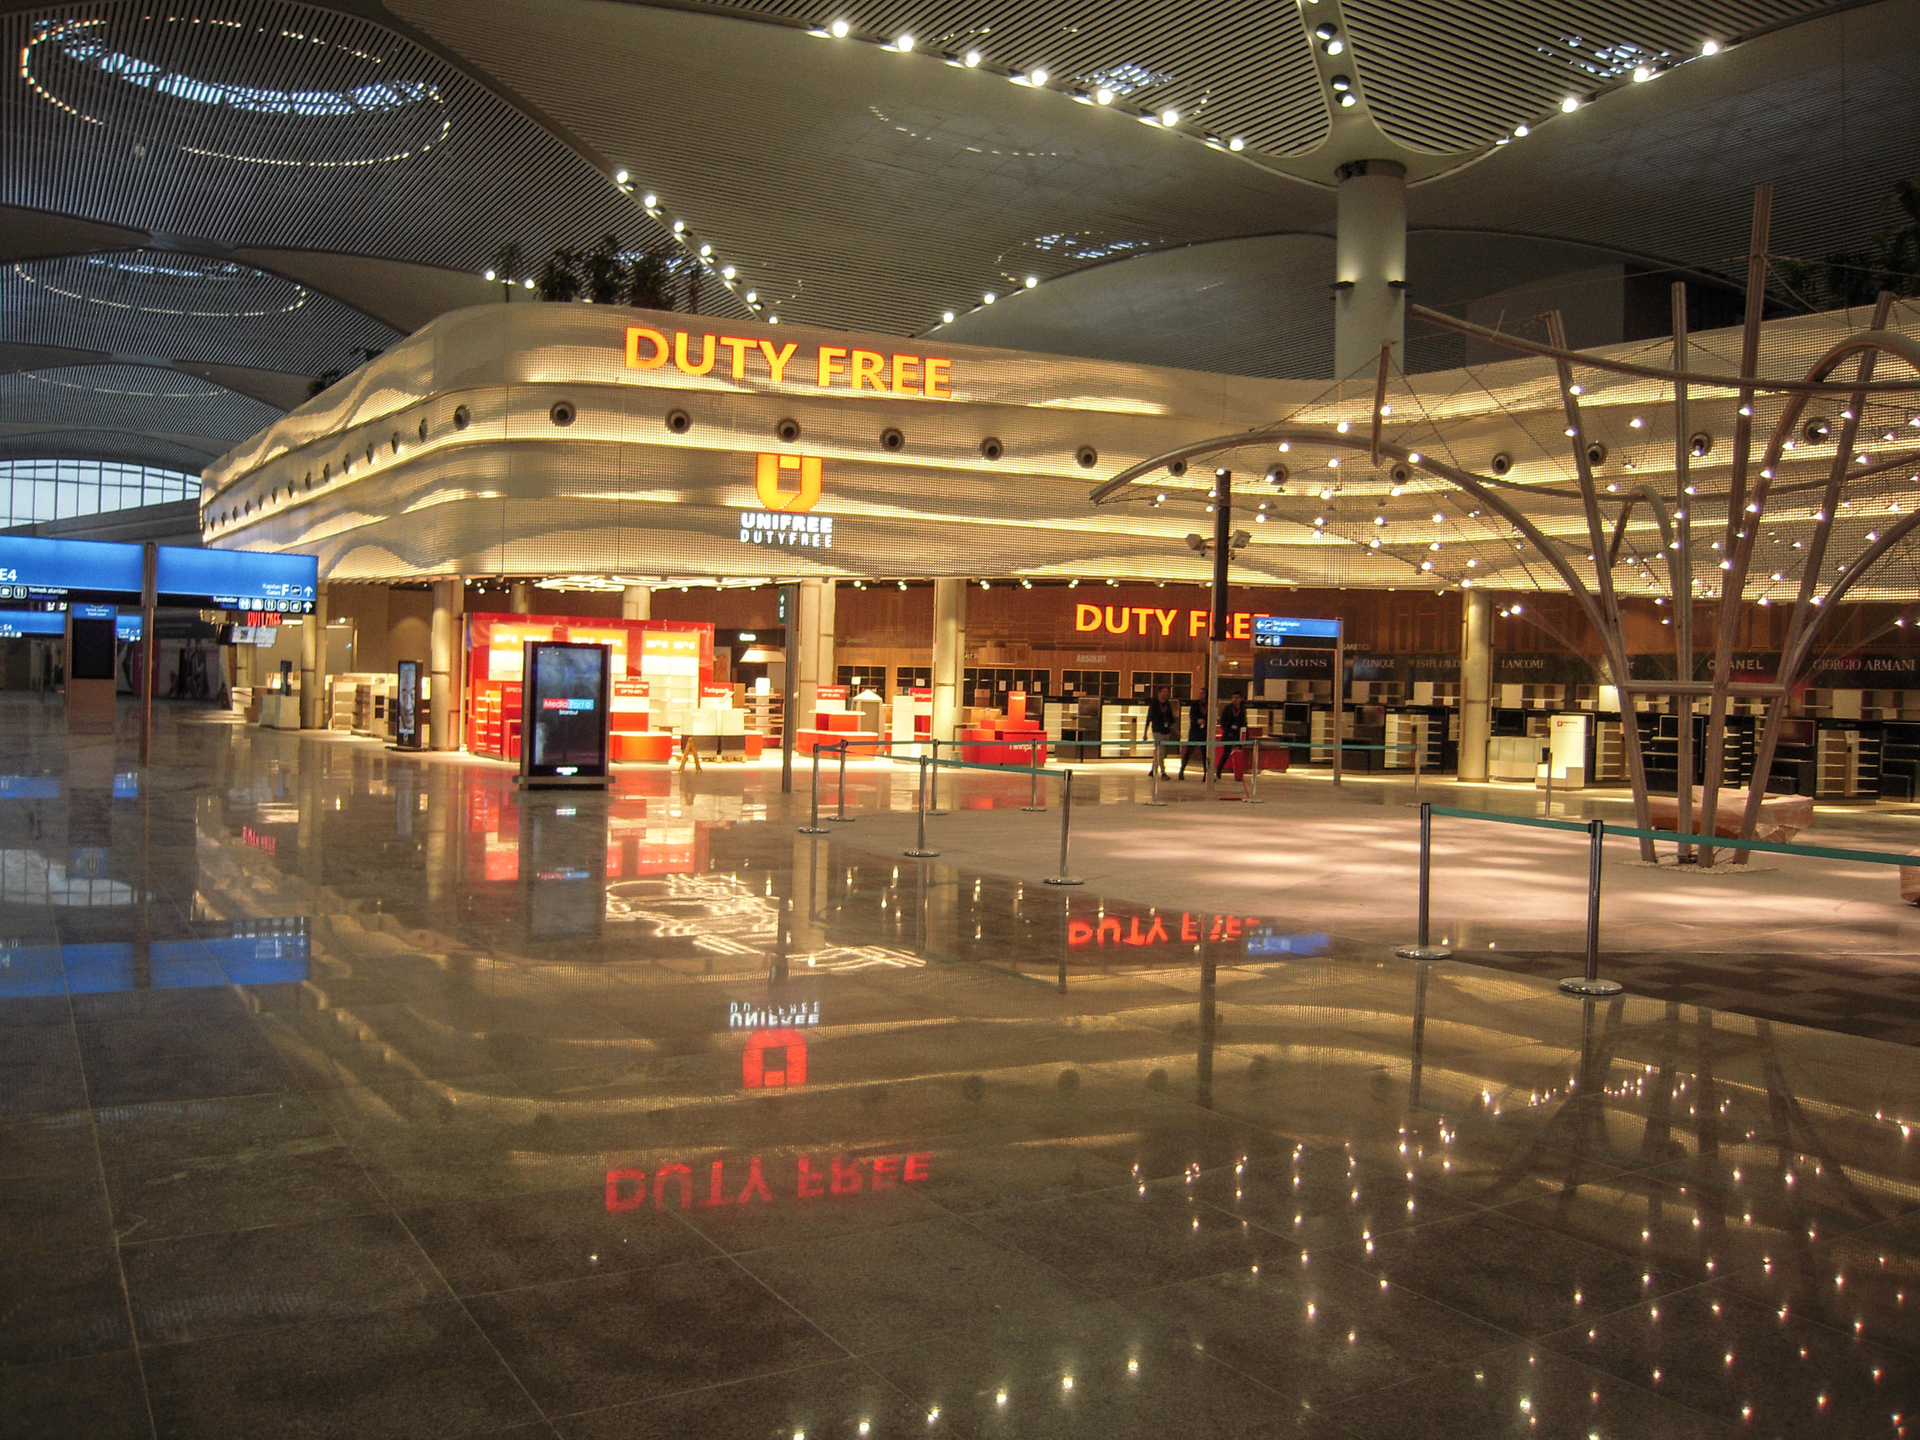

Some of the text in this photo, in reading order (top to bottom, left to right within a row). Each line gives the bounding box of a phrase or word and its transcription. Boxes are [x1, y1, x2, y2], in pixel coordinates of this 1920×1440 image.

[625, 326, 952, 398] DUTY FREE
[741, 512, 833, 533] UNIFREE
[740, 529, 833, 548] DUTYFREE
[0, 568, 18, 581] E4
[281, 584, 290, 596] F
[1075, 603, 1270, 639] DUTY FE
[1076, 655, 1107, 663] ABSOLUT
[1270, 658, 1328, 667] CLARINS
[1364, 659, 1395, 668] CLINIQUE
[1439, 660, 1460, 668] LAUD
[1707, 659, 1764, 670] CANEL
[1814, 659, 1916, 671] GIORGIO ARMANI
[544, 700, 568, 708] Media
